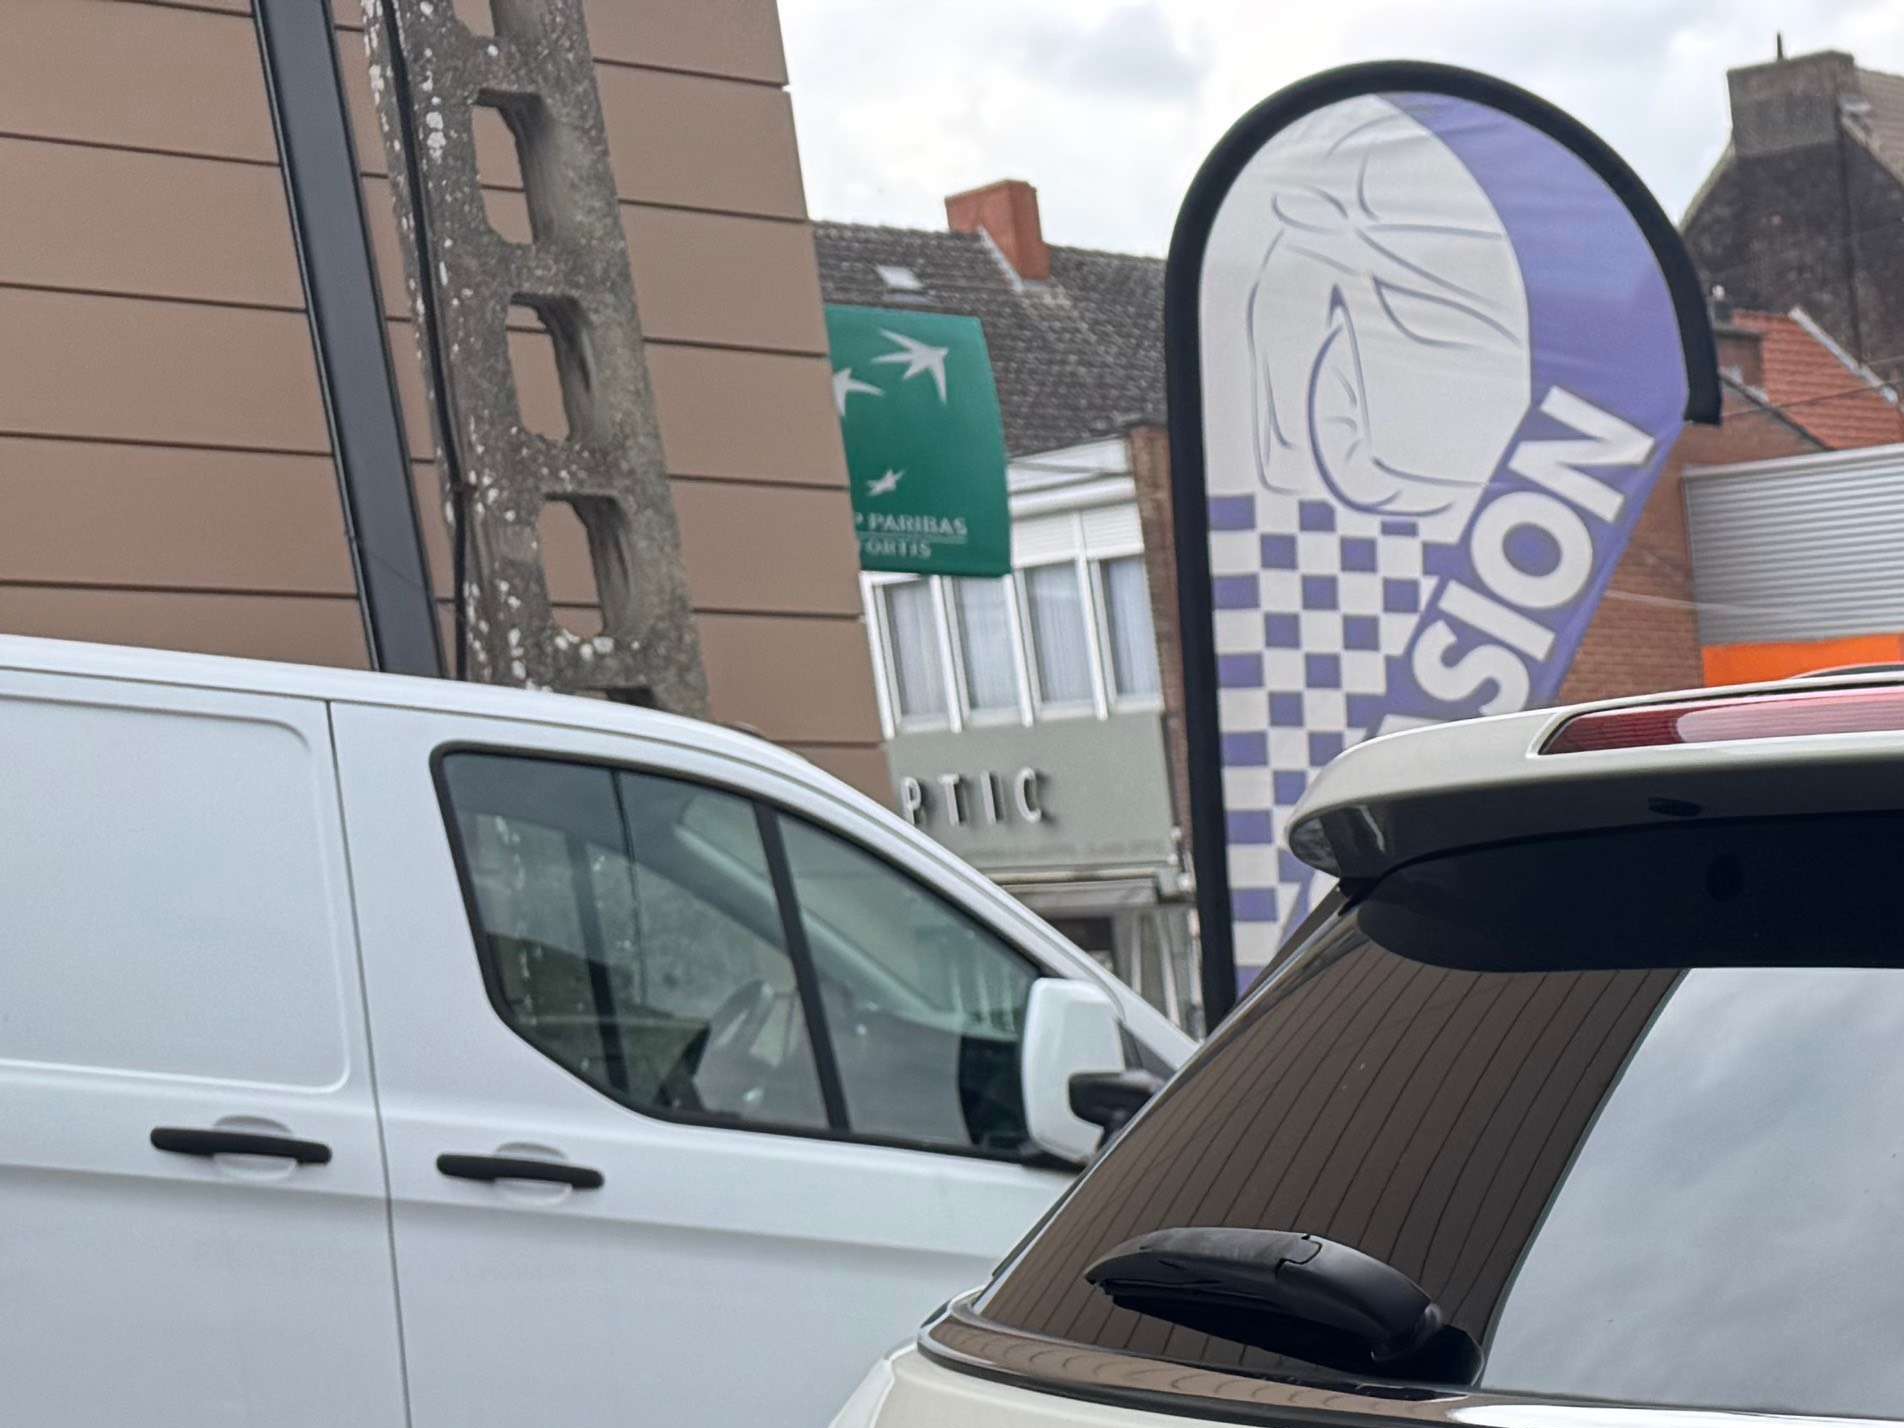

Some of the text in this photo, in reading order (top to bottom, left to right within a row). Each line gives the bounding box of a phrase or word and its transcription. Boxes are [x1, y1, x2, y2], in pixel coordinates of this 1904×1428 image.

[868, 512, 968, 536] PARIBAS
[862, 536, 932, 560] ORTIS
[1376, 385, 1655, 735] SION
